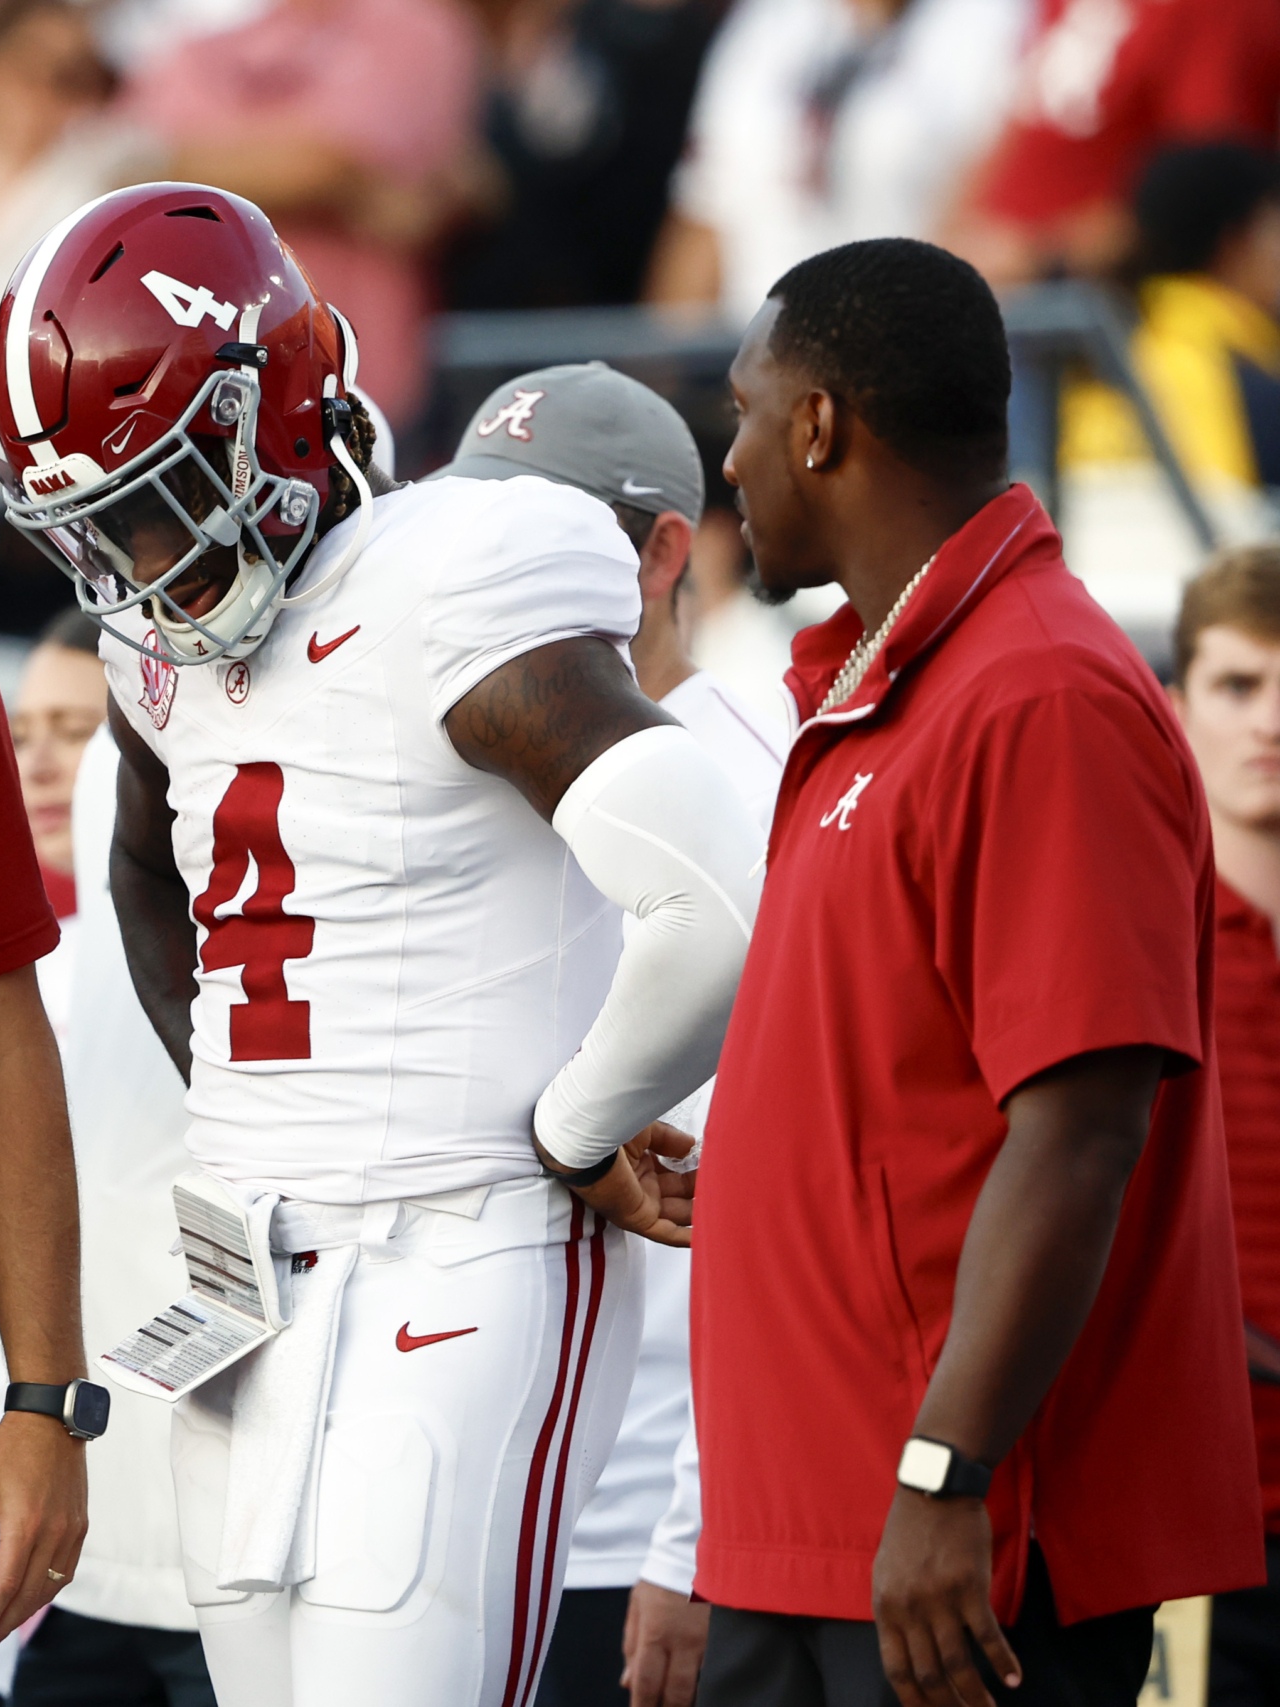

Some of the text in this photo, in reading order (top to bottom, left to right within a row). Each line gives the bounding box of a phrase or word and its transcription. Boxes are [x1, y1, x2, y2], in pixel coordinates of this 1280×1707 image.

[140, 270, 239, 332] 4
[477, 388, 546, 442] A
[228, 667, 246, 694] A
[819, 771, 874, 831] A
[193, 761, 316, 1062] 4
